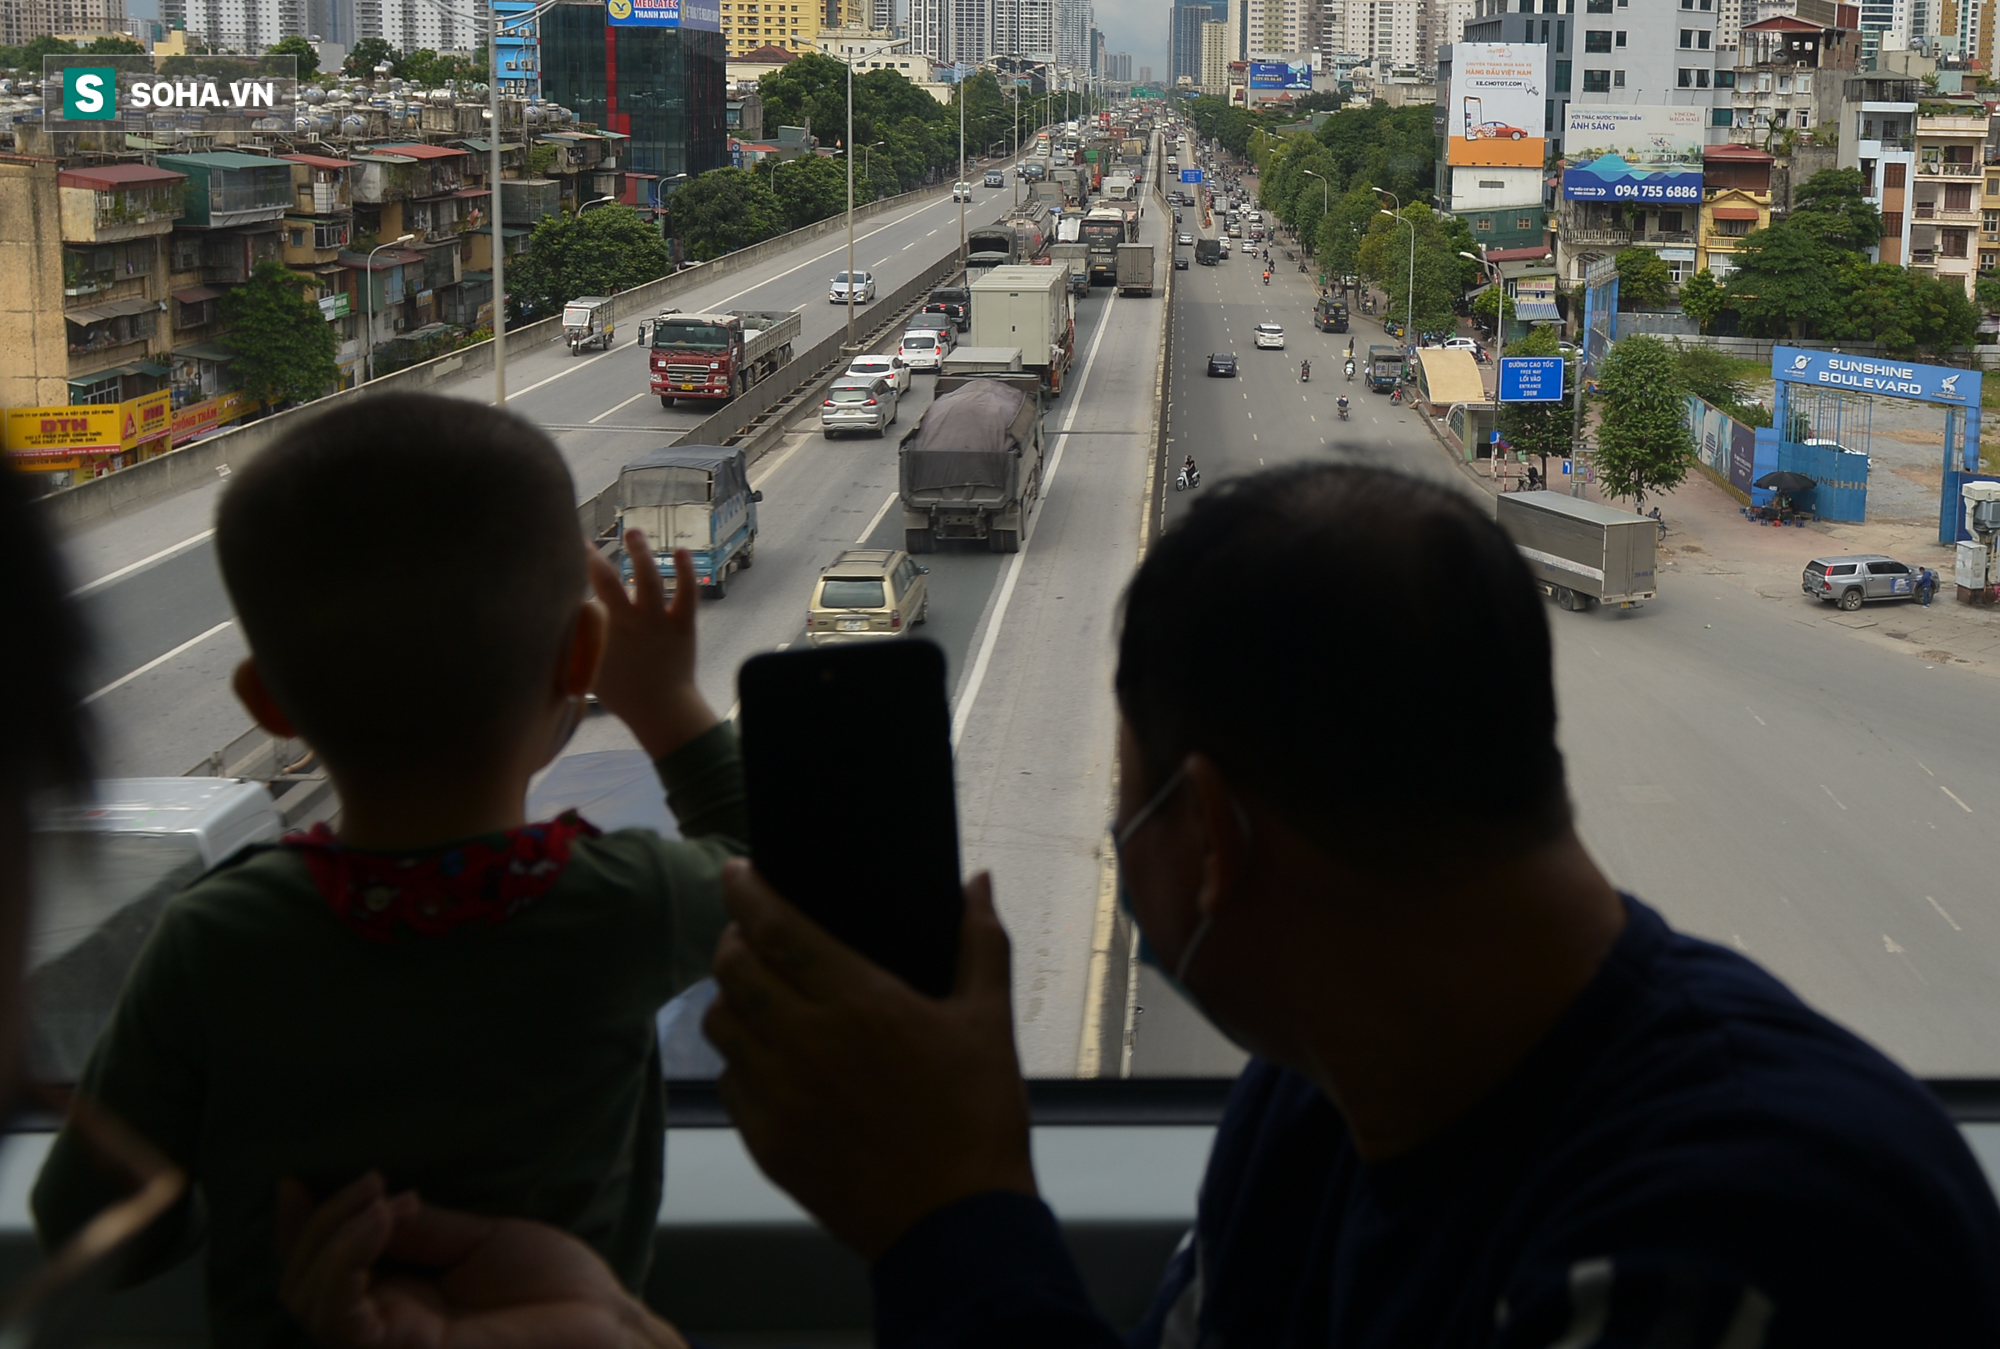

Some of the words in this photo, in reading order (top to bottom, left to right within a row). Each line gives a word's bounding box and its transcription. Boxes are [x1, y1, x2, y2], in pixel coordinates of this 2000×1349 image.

[634, 10, 659, 19] THANH
[660, 9, 679, 19] XUÂN
[1571, 120, 1589, 130] ÁNH
[1591, 121, 1615, 130] SÁNG
[1615, 185, 1639, 197] 094
[1641, 186, 1663, 197] 755
[1666, 186, 1698, 198] 6886
[1542, 360, 1554, 368] TỐC
[1828, 359, 1913, 379] SUNSHINE
[1818, 371, 1922, 395] BOULEVARD
[41, 418, 87, 433] DTH
[172, 414, 196, 432] CHỐNG
[198, 406, 217, 423] THẤM
